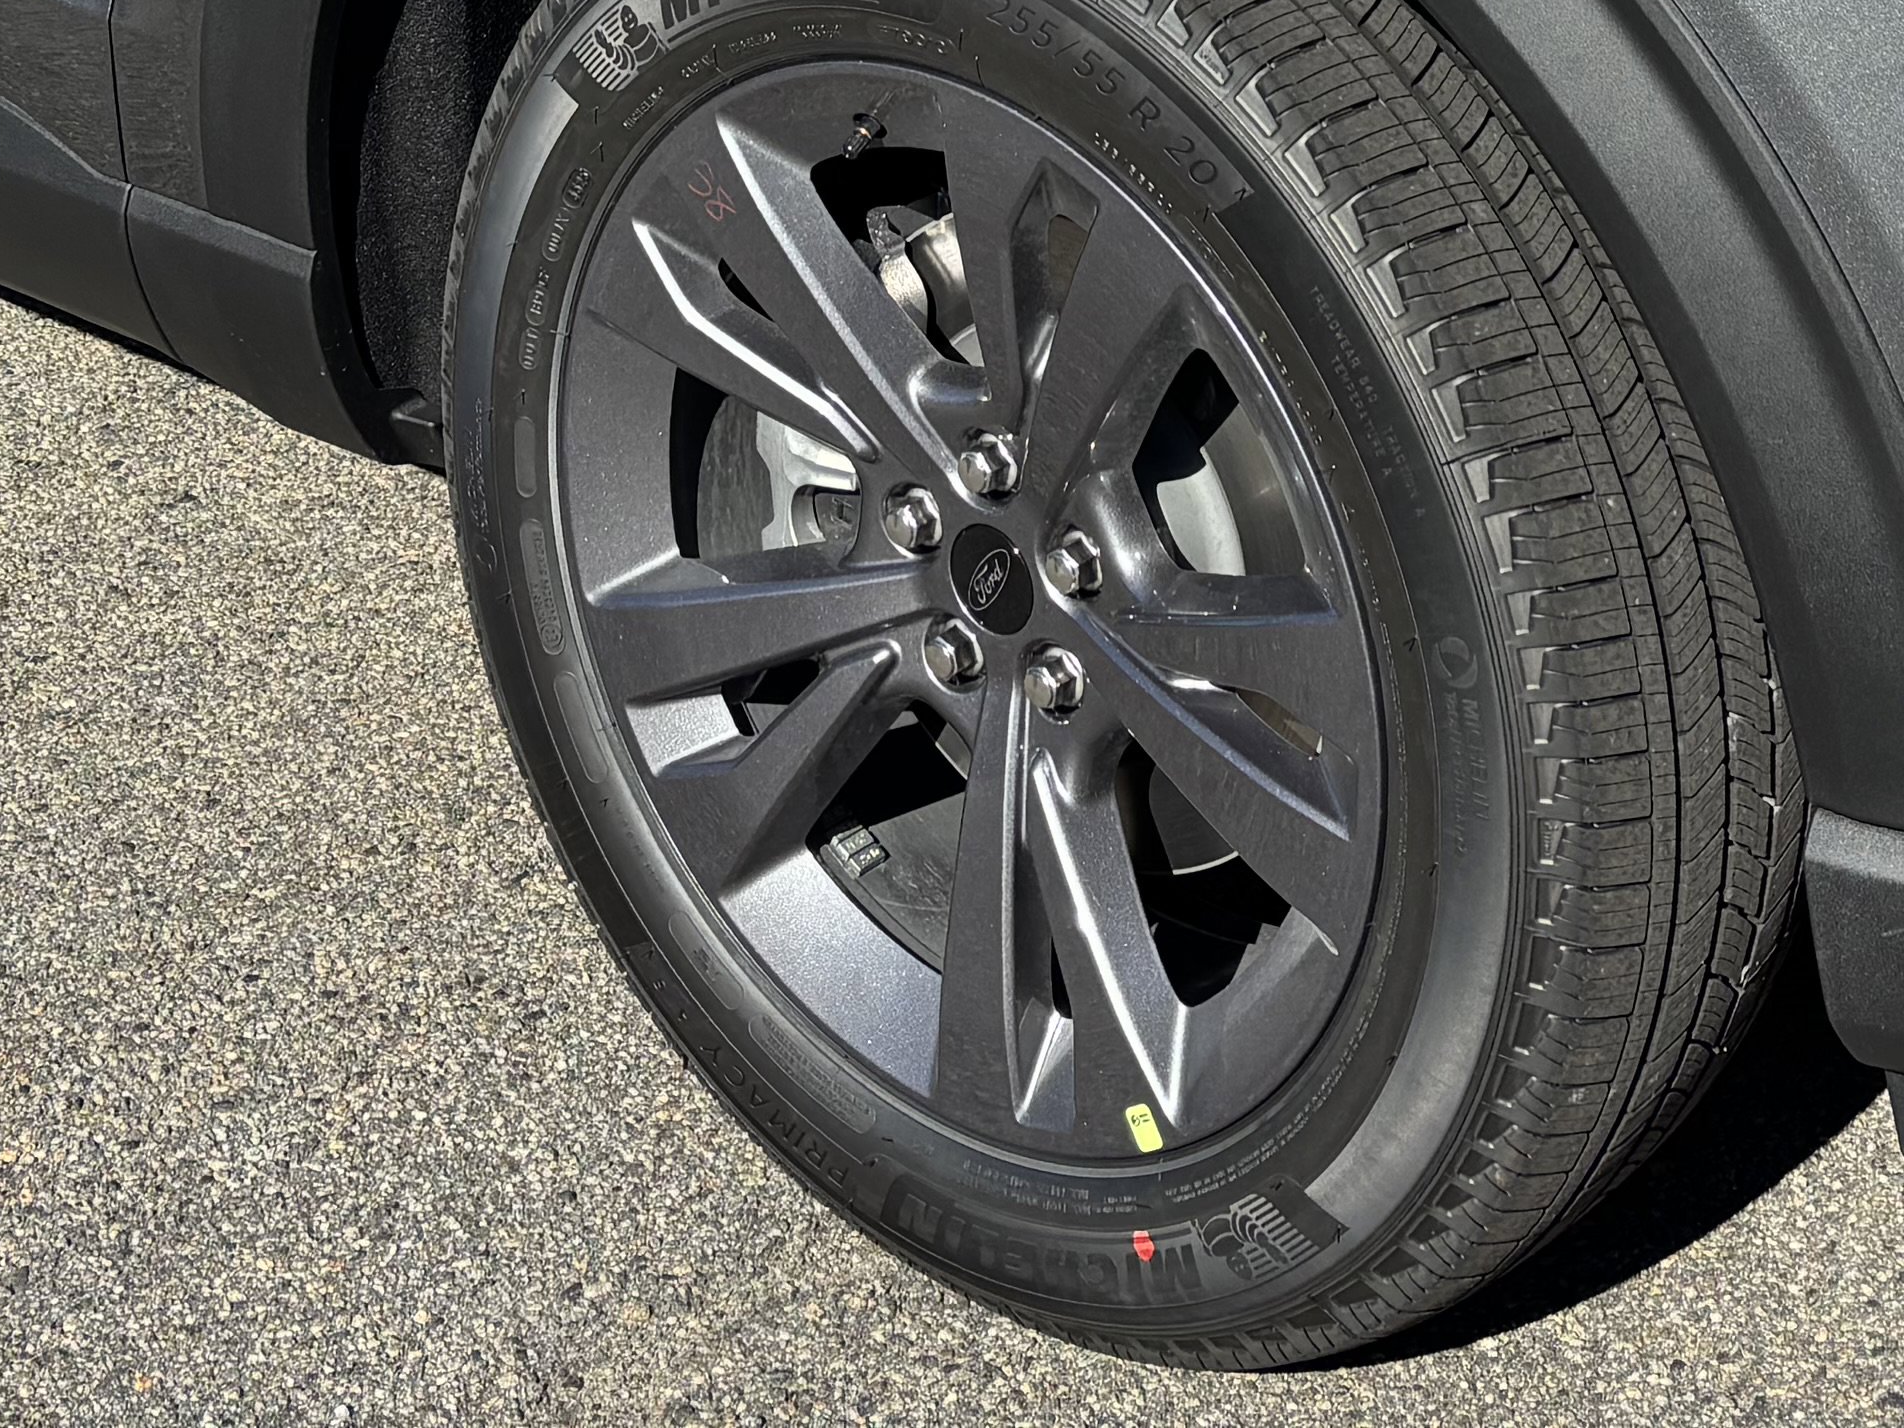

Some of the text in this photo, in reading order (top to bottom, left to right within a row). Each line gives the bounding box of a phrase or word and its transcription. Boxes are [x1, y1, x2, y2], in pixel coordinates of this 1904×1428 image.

[1127, 93, 1162, 136] R
[1162, 132, 1220, 188] 20
[1307, 283, 1362, 369] TREADWEAR
[1328, 353, 1385, 457] TEMPERATURE
[974, 558, 1004, 605] Ford
[696, 1033, 849, 1191] PRIMACY
[898, 1192, 1203, 1297] MICHELIN
